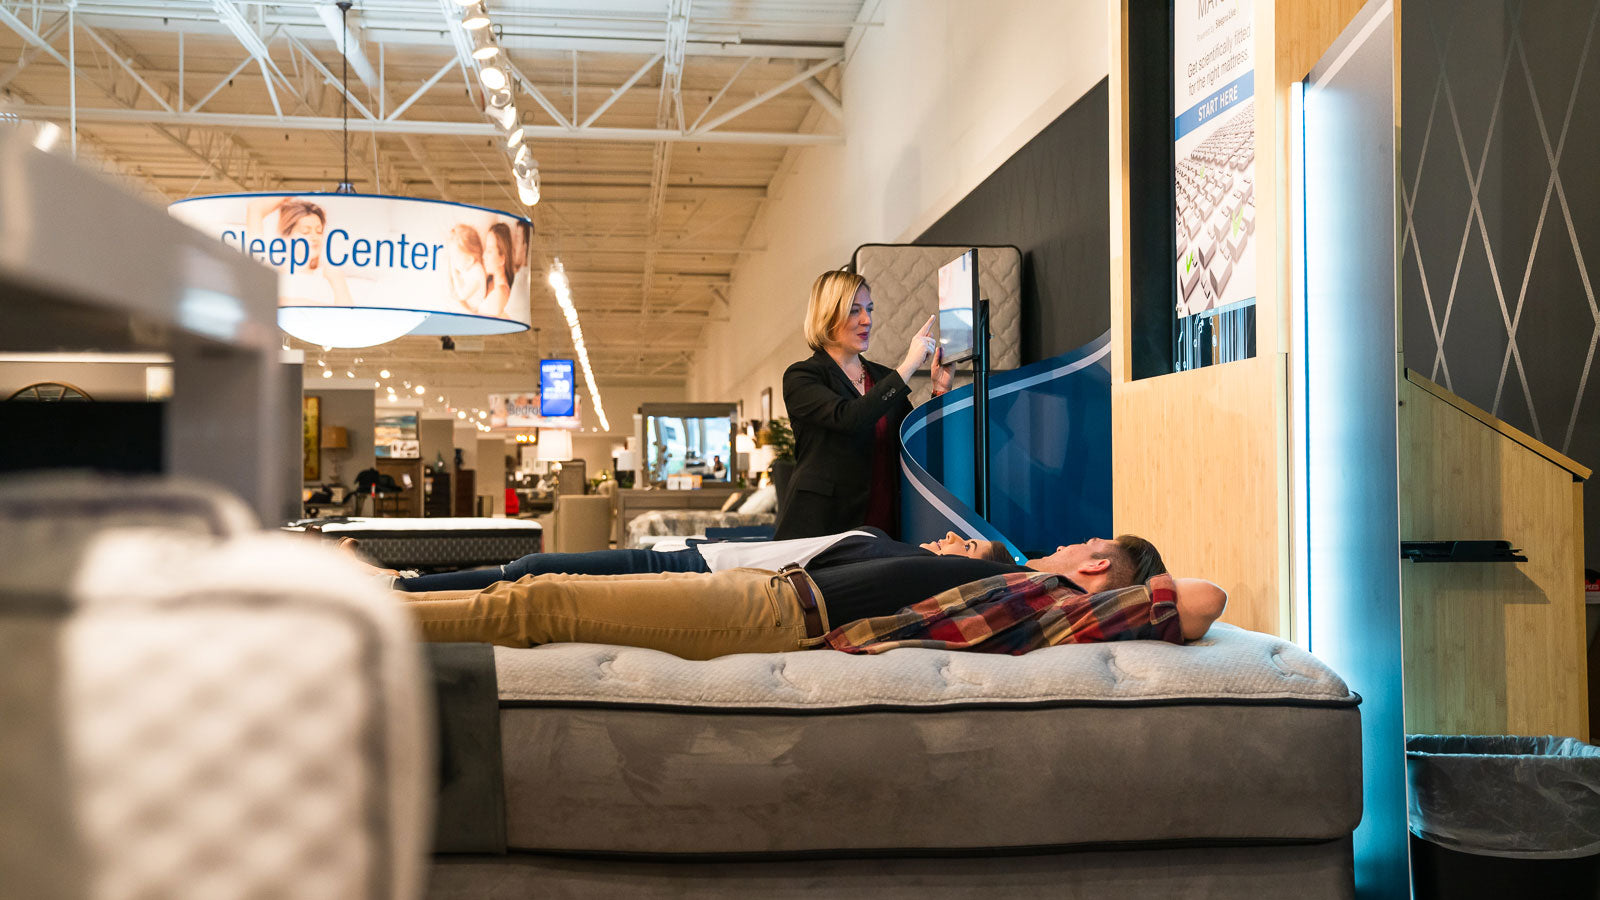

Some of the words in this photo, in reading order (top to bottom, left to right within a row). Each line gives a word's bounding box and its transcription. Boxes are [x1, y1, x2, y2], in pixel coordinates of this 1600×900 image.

[1187, 60, 1198, 78] Get
[1198, 35, 1232, 71] scientifically
[1206, 64, 1220, 86] right
[1198, 96, 1219, 122] START
[1219, 84, 1238, 109] HERE
[326, 228, 444, 271] Center
[508, 402, 541, 416] Bedro
